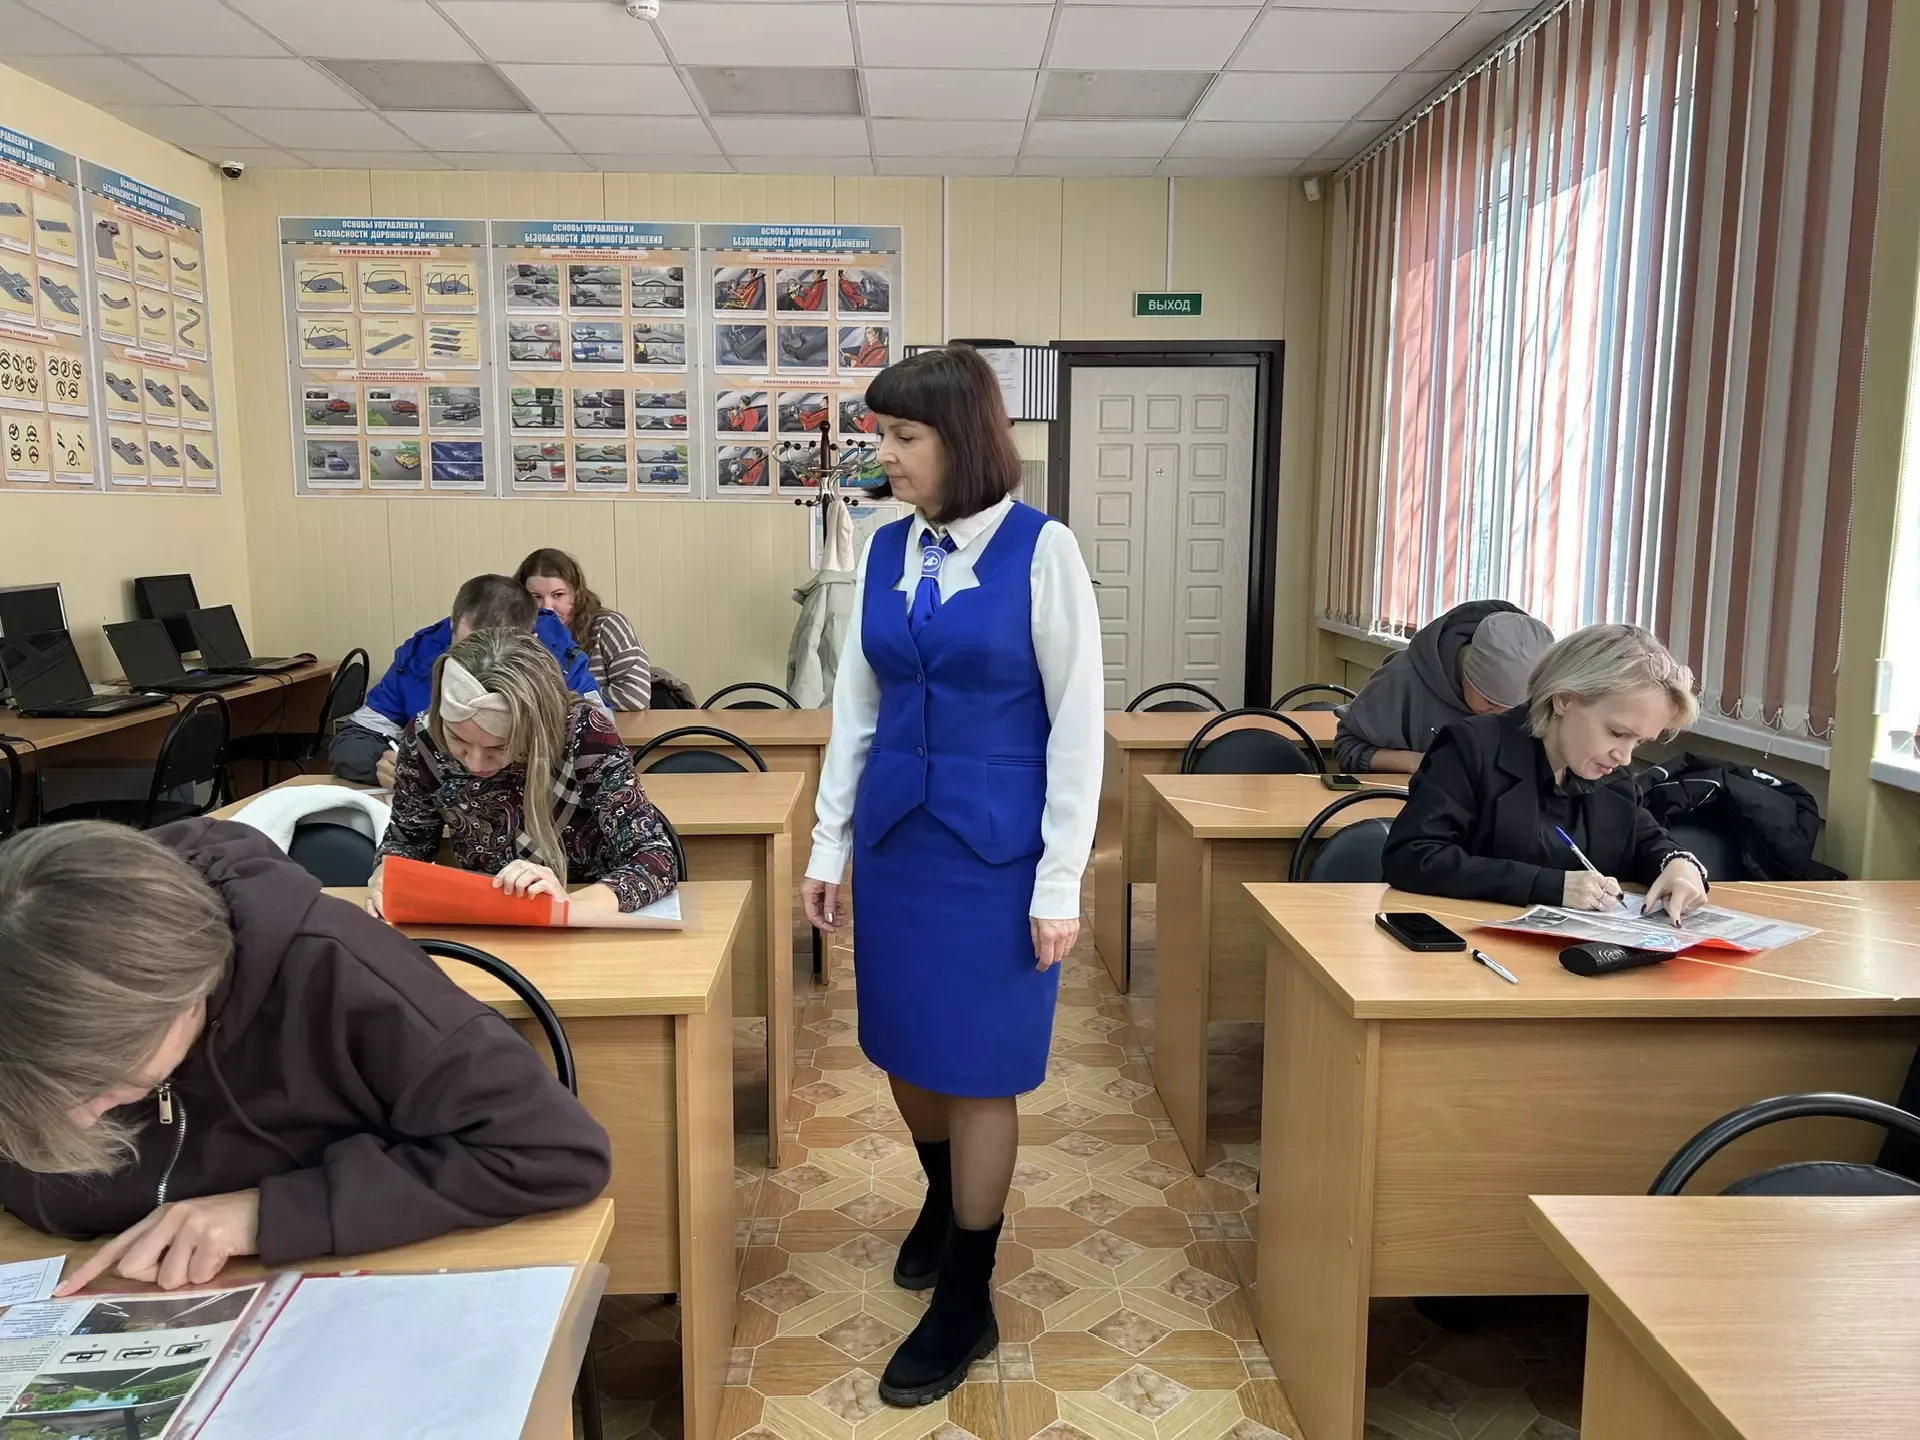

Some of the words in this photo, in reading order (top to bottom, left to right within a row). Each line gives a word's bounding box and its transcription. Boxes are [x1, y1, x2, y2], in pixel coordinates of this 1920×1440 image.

[342, 220, 373, 229] ОСНОВЫ
[373, 220, 418, 230] УПРАВЛЕНИЯ
[419, 221, 425, 230] И
[552, 223, 583, 232] ОСНОВЫ
[583, 224, 628, 233] УПРАВЛЕНИЯ
[629, 224, 635, 233] И
[314, 229, 369, 239] БЕЗОПАСНОСТИ
[370, 230, 414, 240] ДОРОЖНОГО
[414, 231, 454, 241] ДВИЖЕНИЯ
[760, 227, 791, 236] ОСНОВЫ
[791, 227, 836, 236] УПРАВЛЕНИЯ
[836, 228, 842, 236] И
[524, 233, 579, 243] БЕЗОПАСНОСТИ
[580, 234, 624, 244] ДОРОЖНОГО
[624, 235, 663, 245] ДВИЖЕНИЯ
[732, 236, 786, 247] БЕЗОПАСНОСТИ
[788, 237, 831, 248] ДОРОЖНОГО
[831, 238, 870, 249] ДВИЖЕНИЯ
[1148, 299, 1191, 312] ВЫХОД
